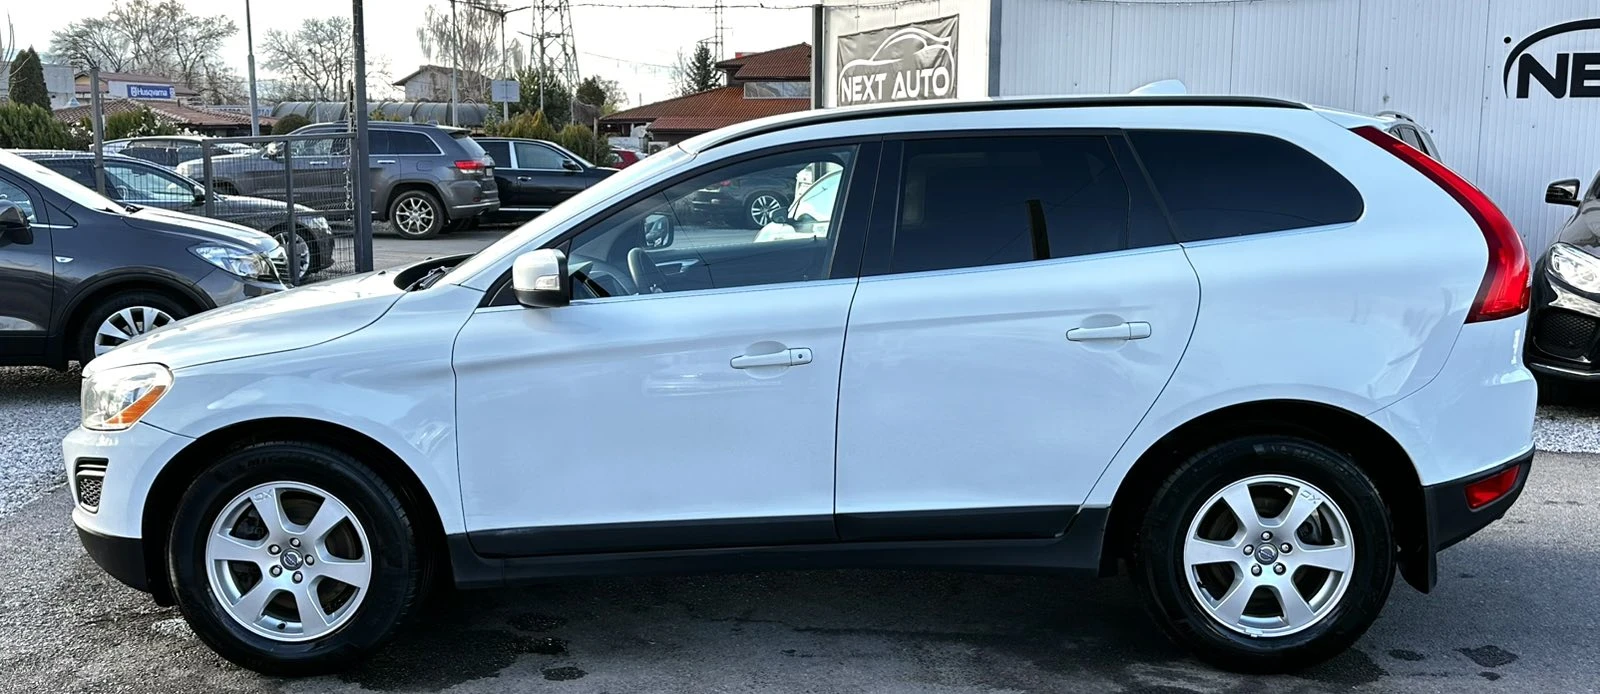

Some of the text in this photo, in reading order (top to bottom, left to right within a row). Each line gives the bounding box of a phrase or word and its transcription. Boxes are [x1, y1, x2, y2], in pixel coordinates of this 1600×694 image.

[138, 87, 168, 97] Husqvarna
[841, 66, 950, 103] NEXT AUTO
